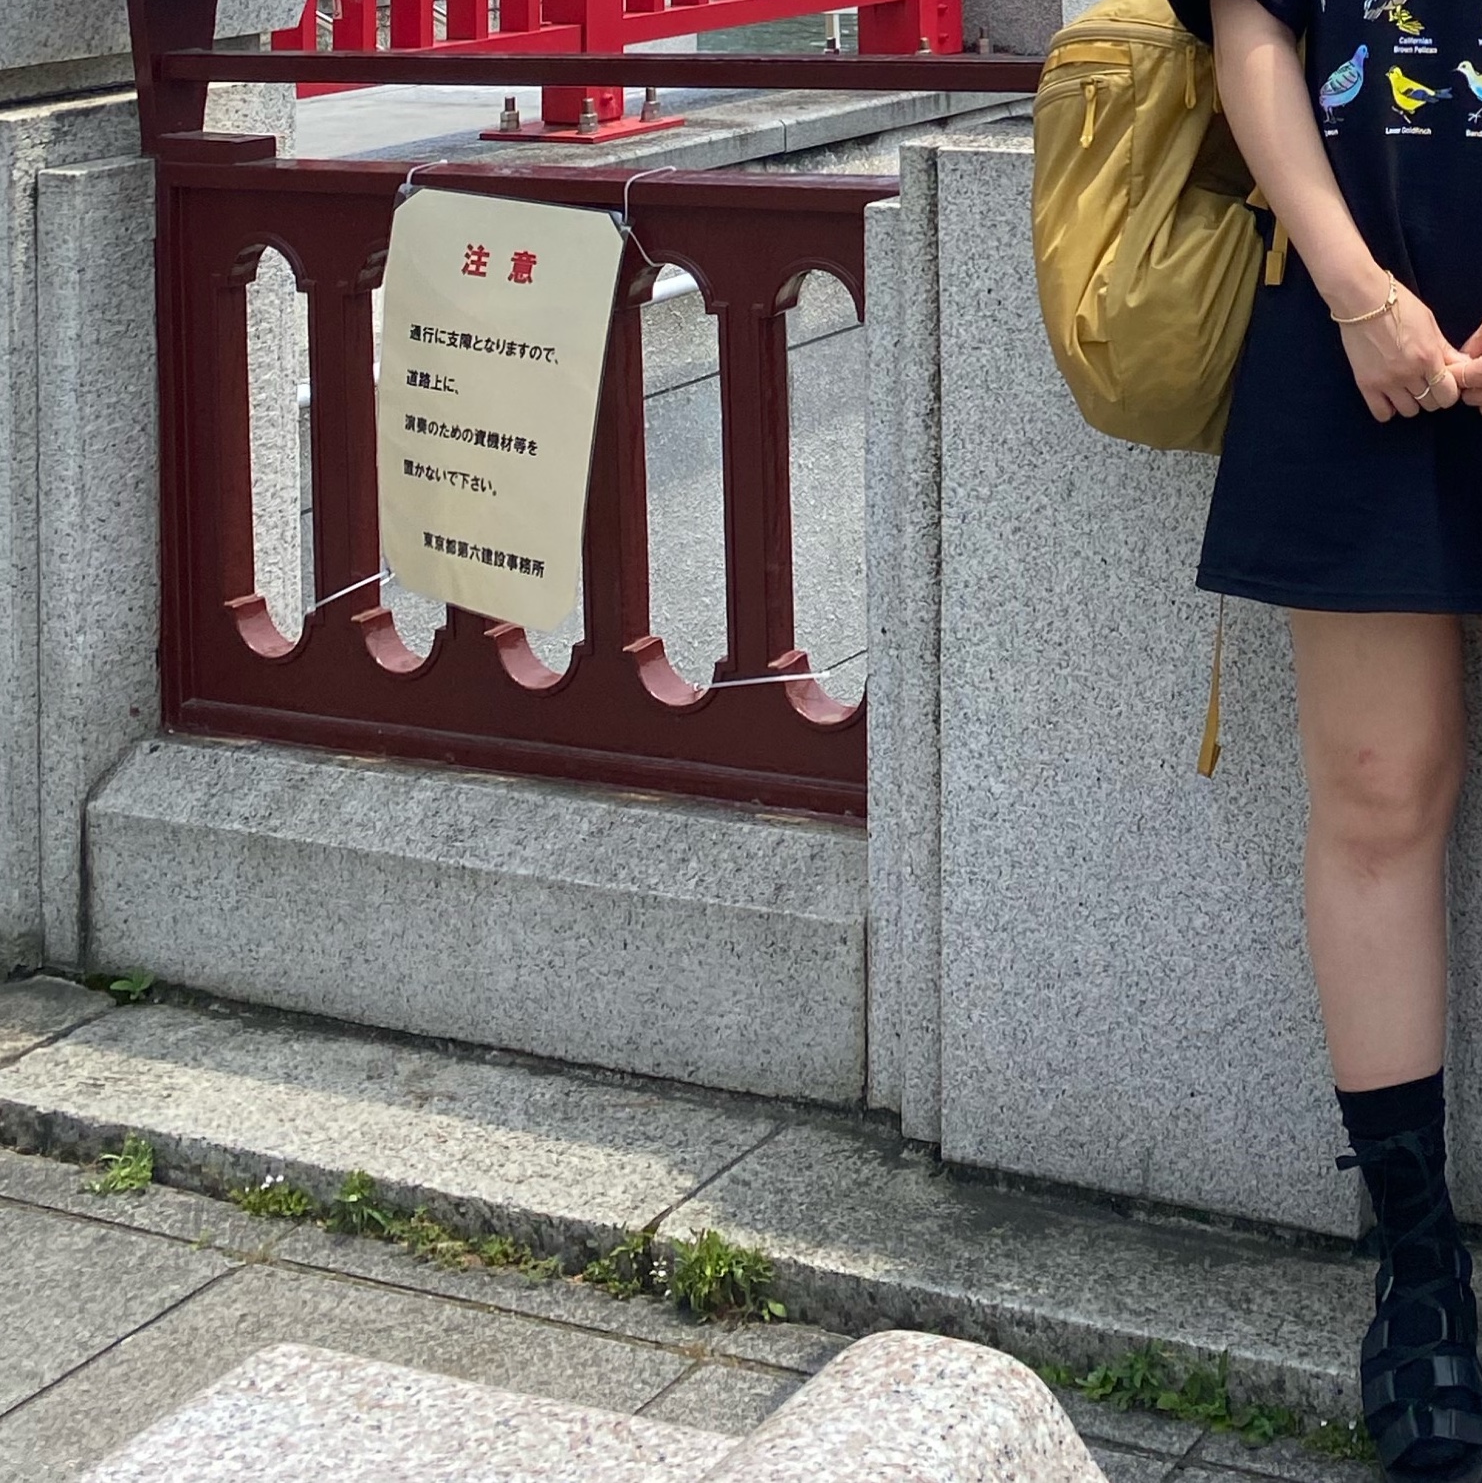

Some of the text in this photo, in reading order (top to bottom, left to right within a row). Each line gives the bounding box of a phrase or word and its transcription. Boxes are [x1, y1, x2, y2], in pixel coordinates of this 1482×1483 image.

[404, 413, 538, 457] 演奏のための資機材等を
[423, 531, 545, 579] 東京都第六建設事務所
